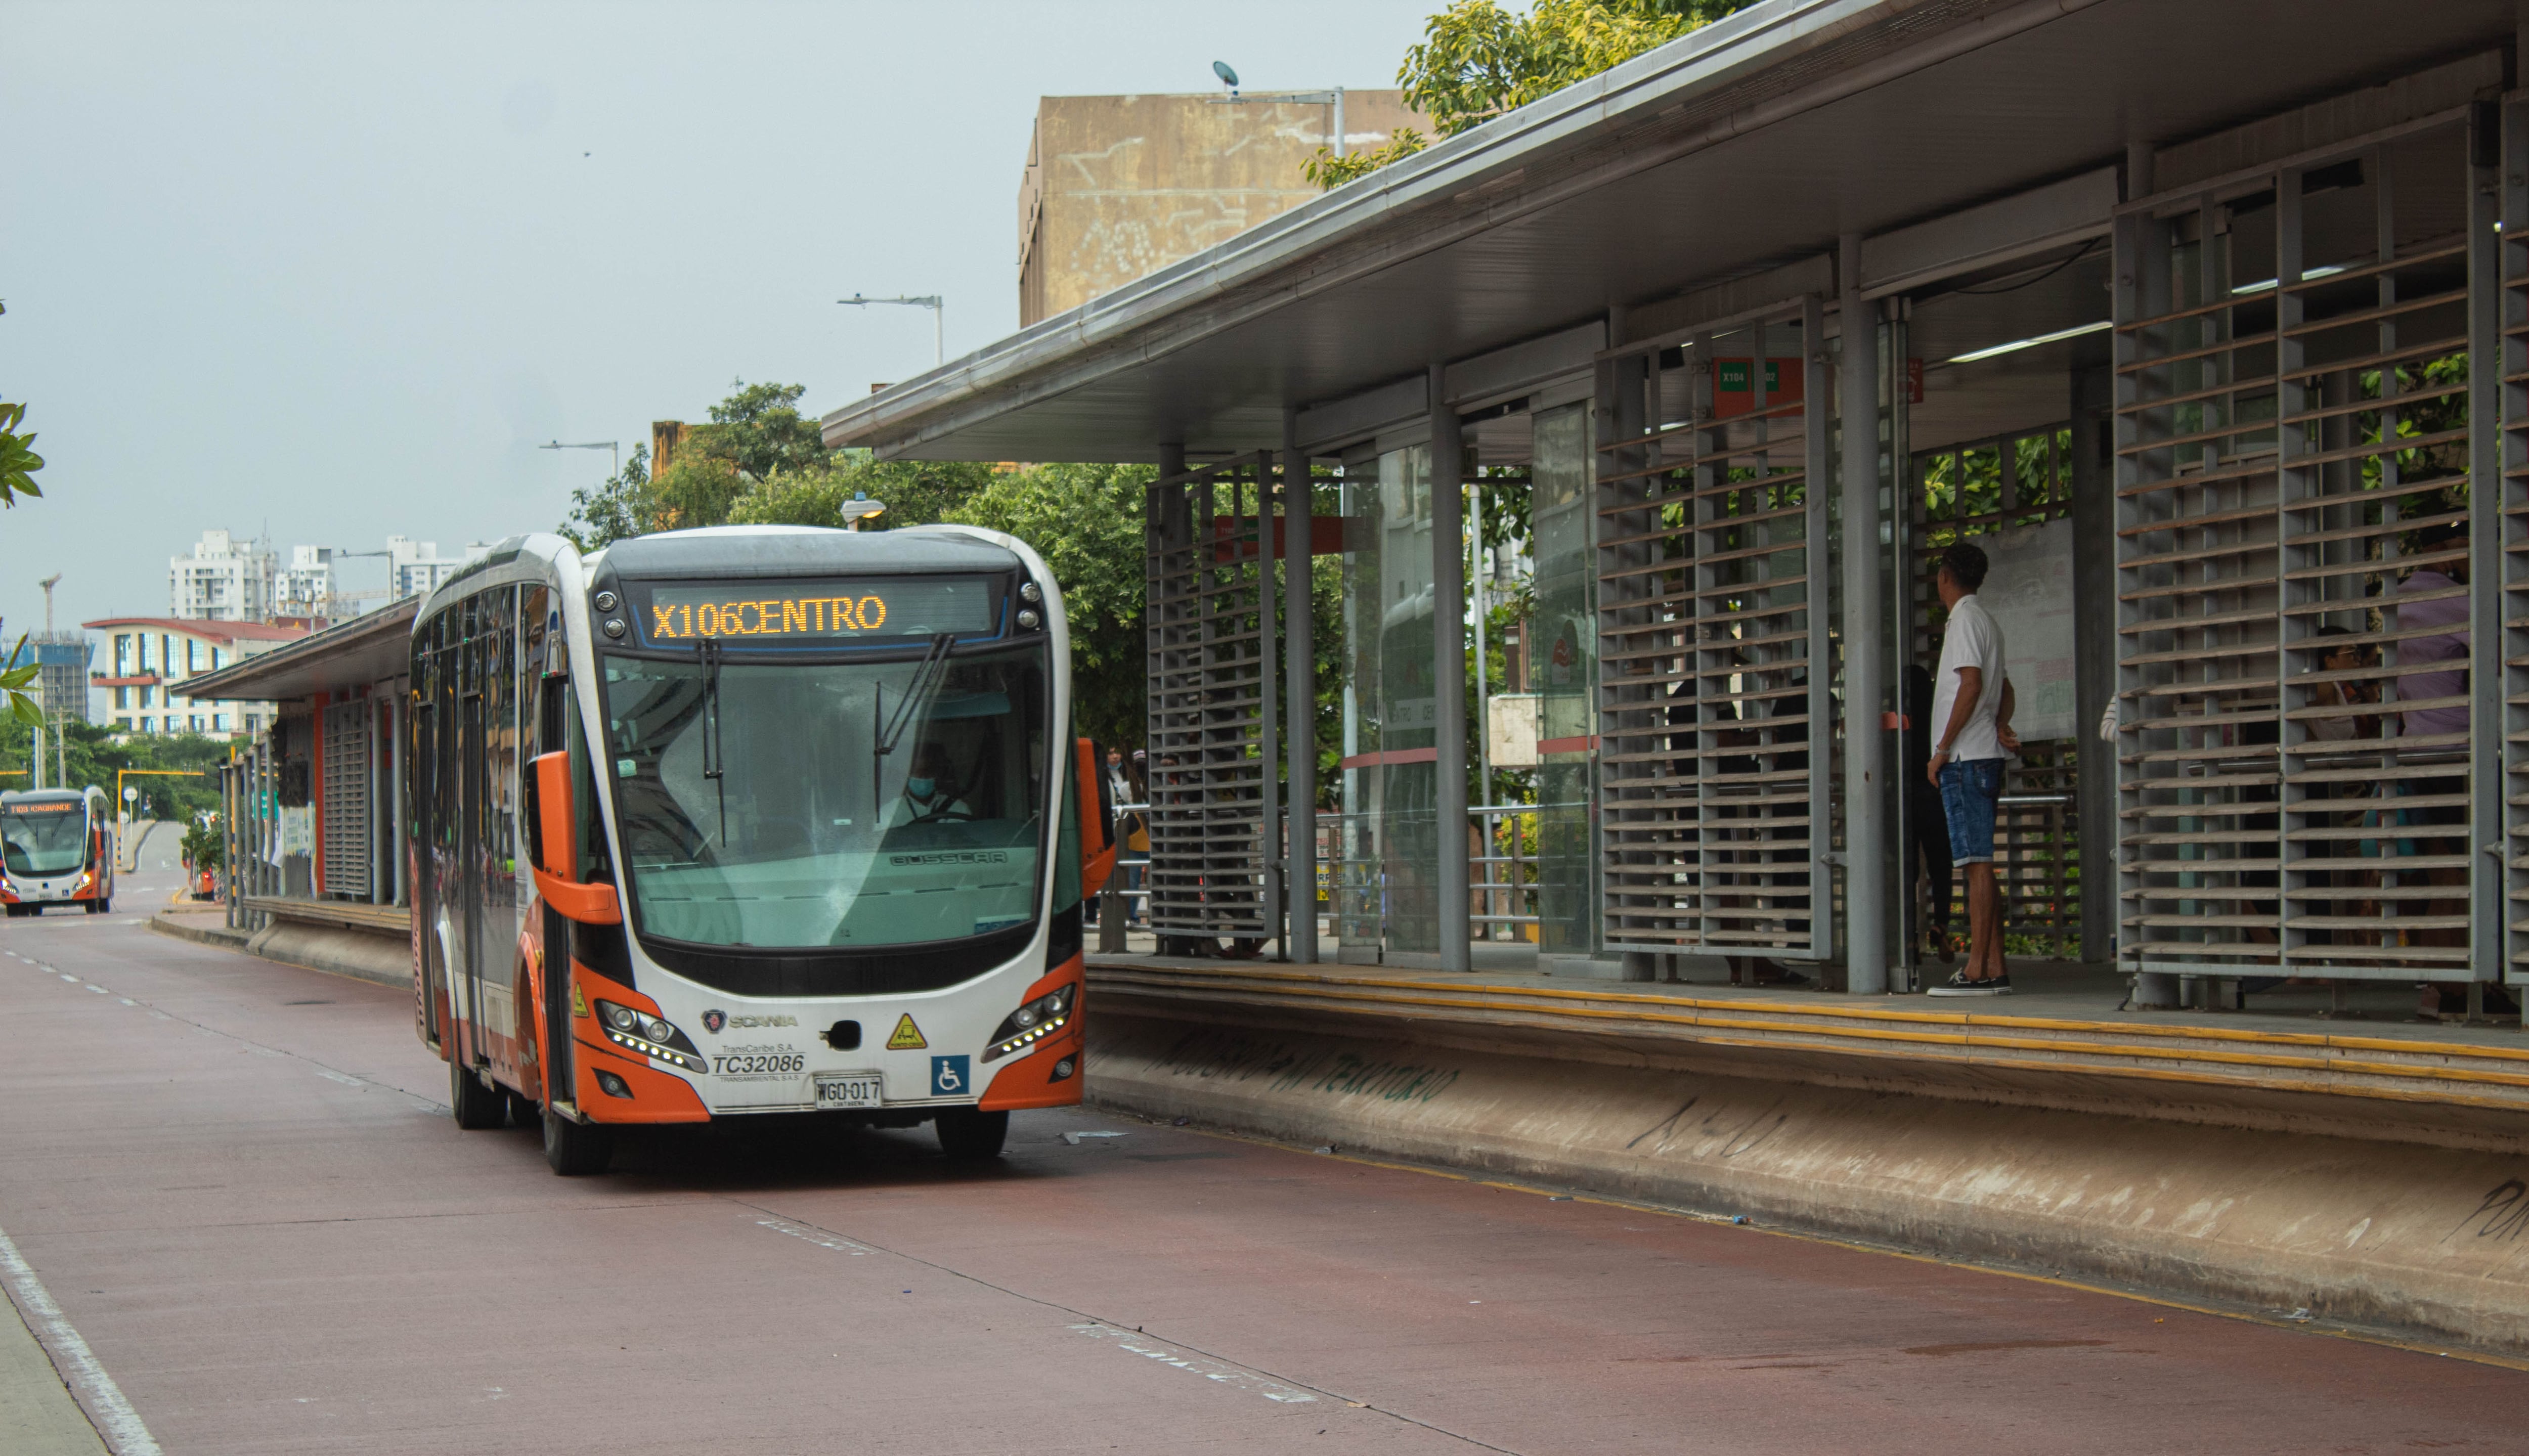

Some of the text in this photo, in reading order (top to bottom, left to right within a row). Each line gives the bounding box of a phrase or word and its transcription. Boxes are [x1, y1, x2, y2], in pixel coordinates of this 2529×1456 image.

[1723, 372, 1745, 382] X104
[890, 852, 1008, 866] BUSSCAR
[729, 1015, 798, 1028] SCANIA
[722, 1043, 795, 1054] TransCaribe S.A.
[713, 1054, 804, 1074] TC32086
